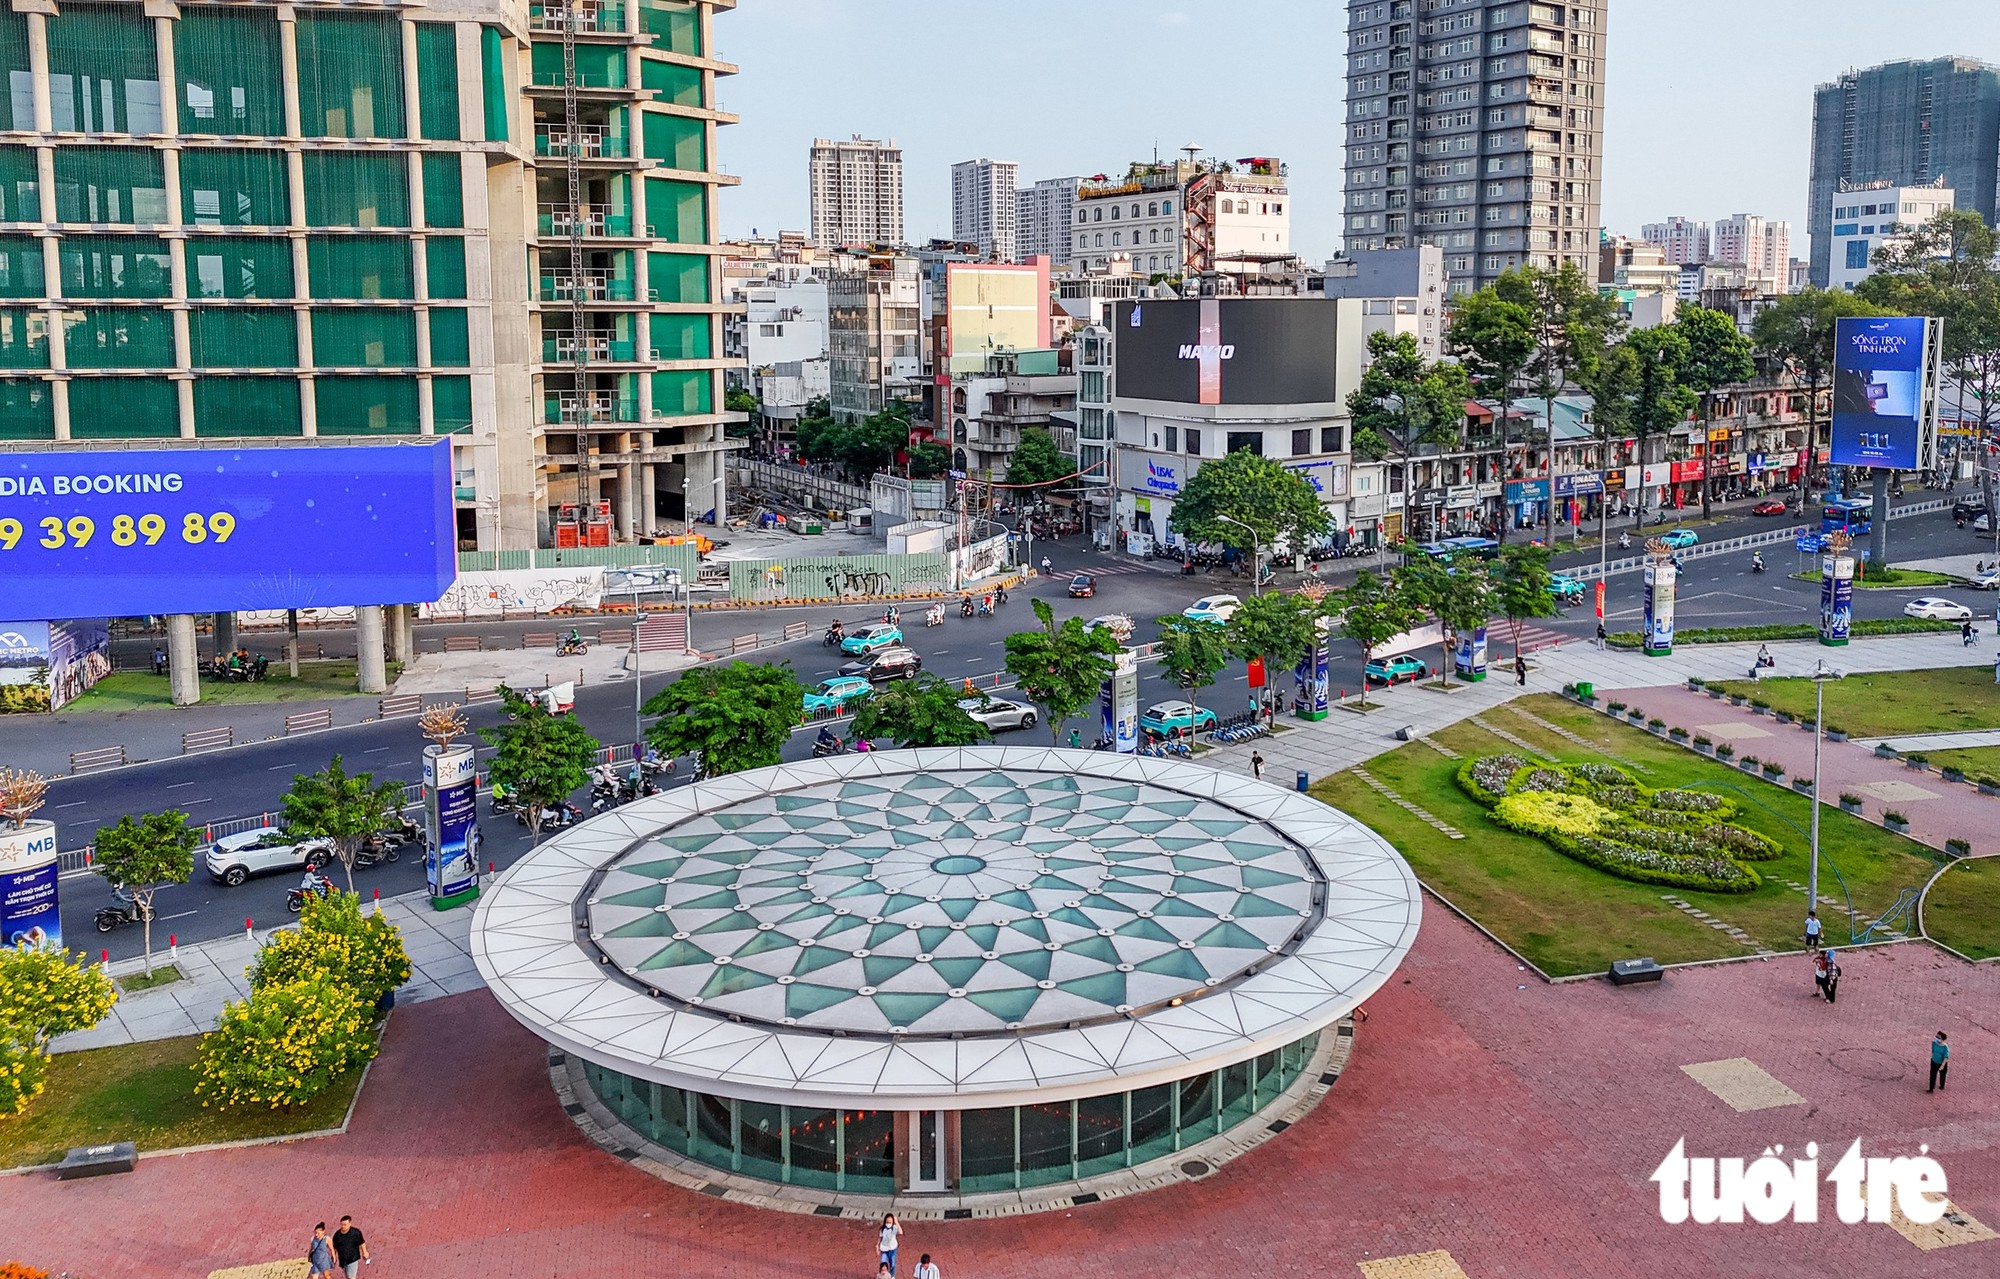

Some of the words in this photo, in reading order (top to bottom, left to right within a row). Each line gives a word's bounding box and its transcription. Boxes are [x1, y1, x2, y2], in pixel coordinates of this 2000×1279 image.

[1240, 183, 1266, 194] Garden
[1156, 466, 1175, 479] USAC
[53, 472, 184, 496] BOOKING
[39, 515, 96, 549] 39
[111, 513, 166, 547] 89
[181, 511, 237, 544] 89
[10, 647, 39, 655] METRO
[458, 757, 474, 773] MB
[27, 837, 54, 856] MB
[23, 874, 36, 883] MB
